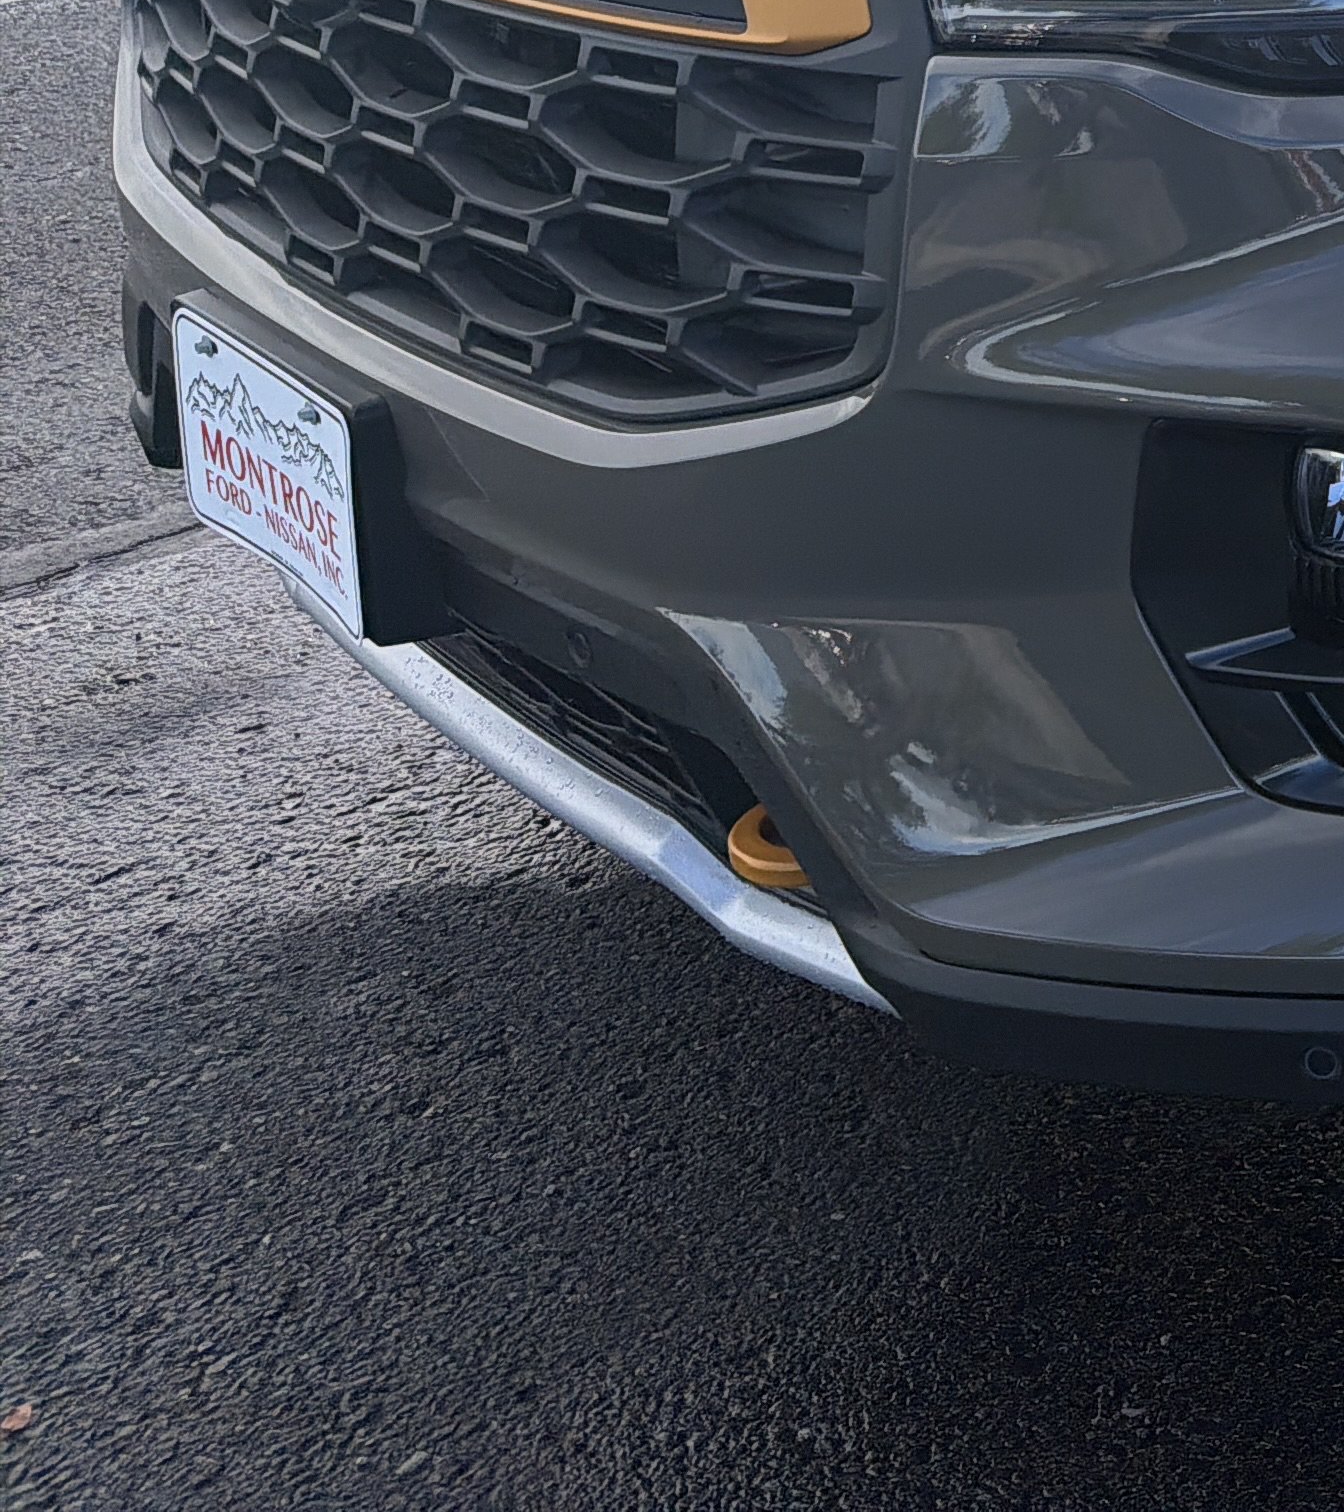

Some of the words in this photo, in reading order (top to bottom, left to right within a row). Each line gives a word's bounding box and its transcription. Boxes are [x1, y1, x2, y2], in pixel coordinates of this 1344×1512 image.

[200, 419, 342, 562] MONTROSE
[205, 467, 252, 517] FORD
[322, 549, 348, 601] INC.
